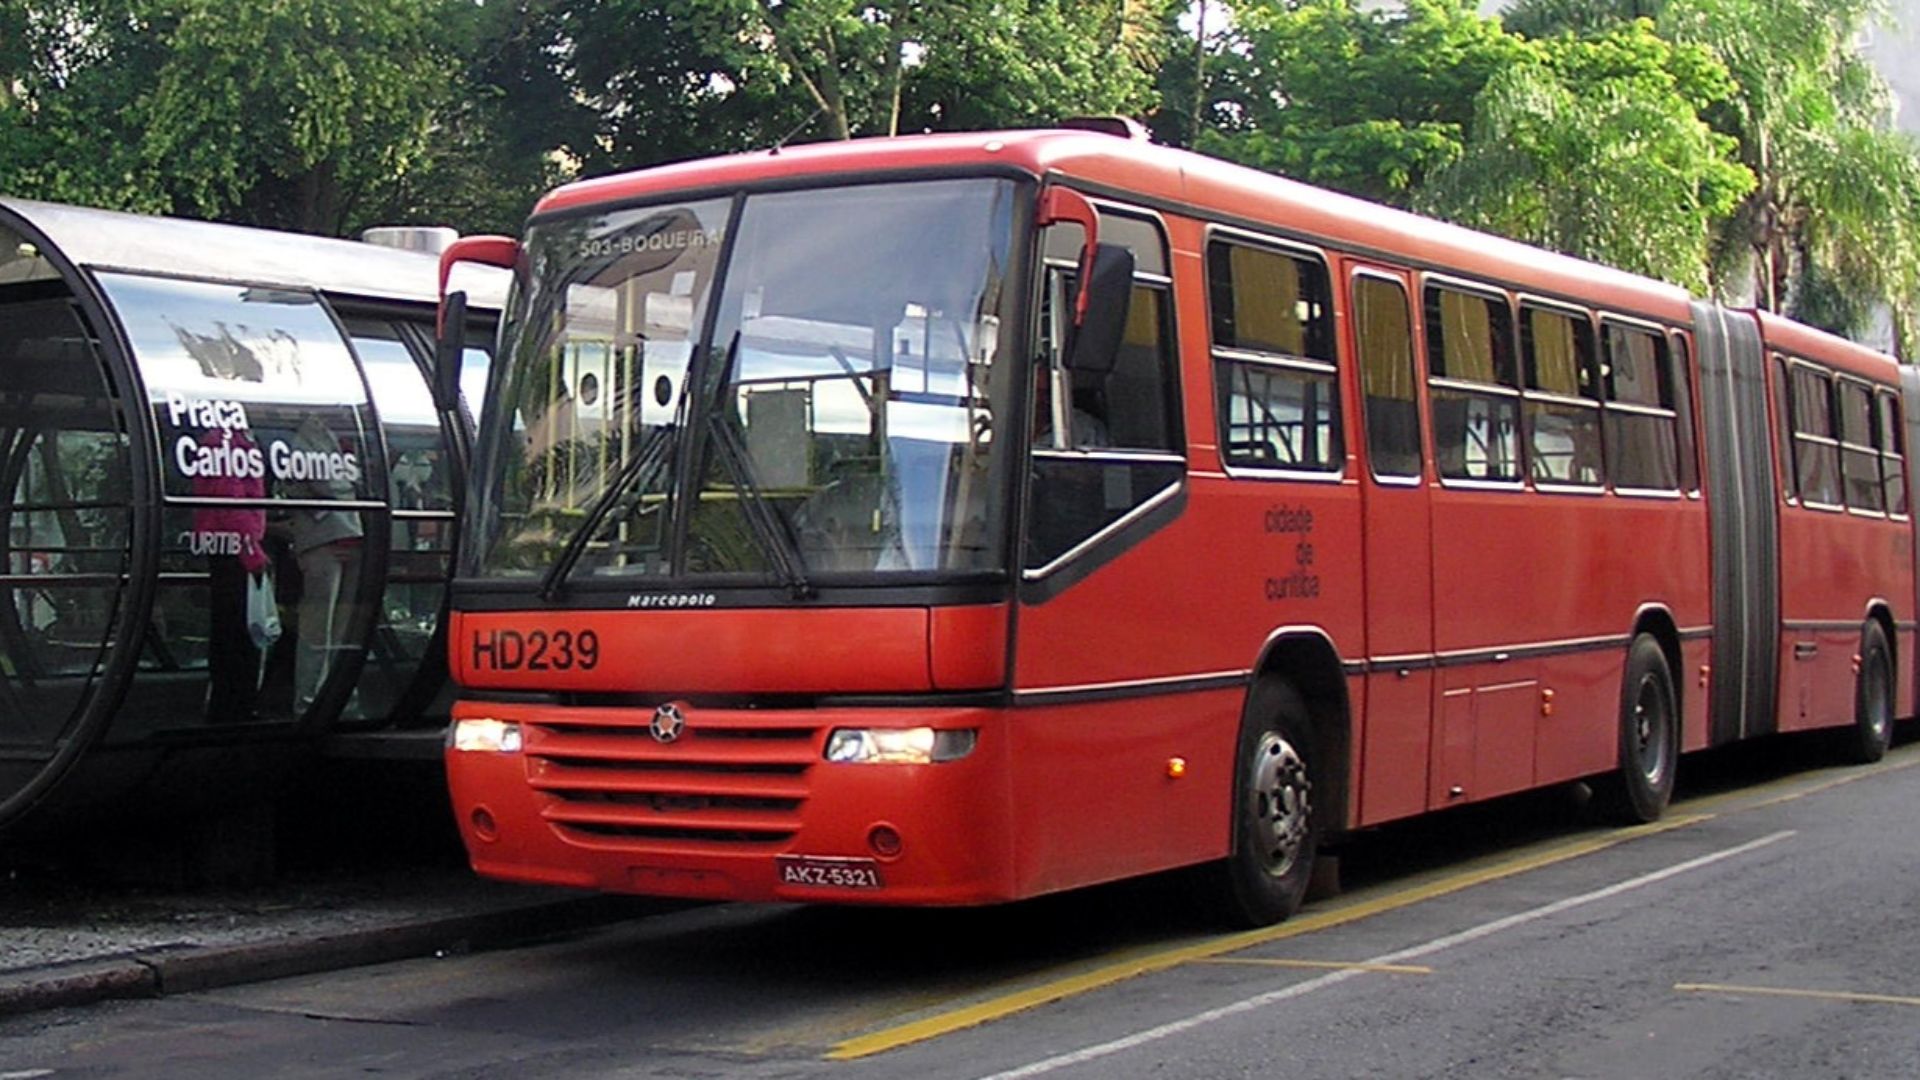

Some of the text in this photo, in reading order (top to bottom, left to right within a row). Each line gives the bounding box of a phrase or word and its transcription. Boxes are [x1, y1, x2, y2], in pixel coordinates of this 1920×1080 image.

[579, 228, 726, 258] 503-BOQUEIRA
[166, 388, 249, 440] Praça
[175, 435, 362, 482] Carlos Gomes
[1264, 503, 1314, 534] cidade
[1296, 535, 1313, 565] de
[1264, 570, 1320, 600] curitiba
[627, 594, 717, 608] Marcopolo
[472, 629, 600, 671] HD239
[784, 865, 878, 887] AKZ-5321
